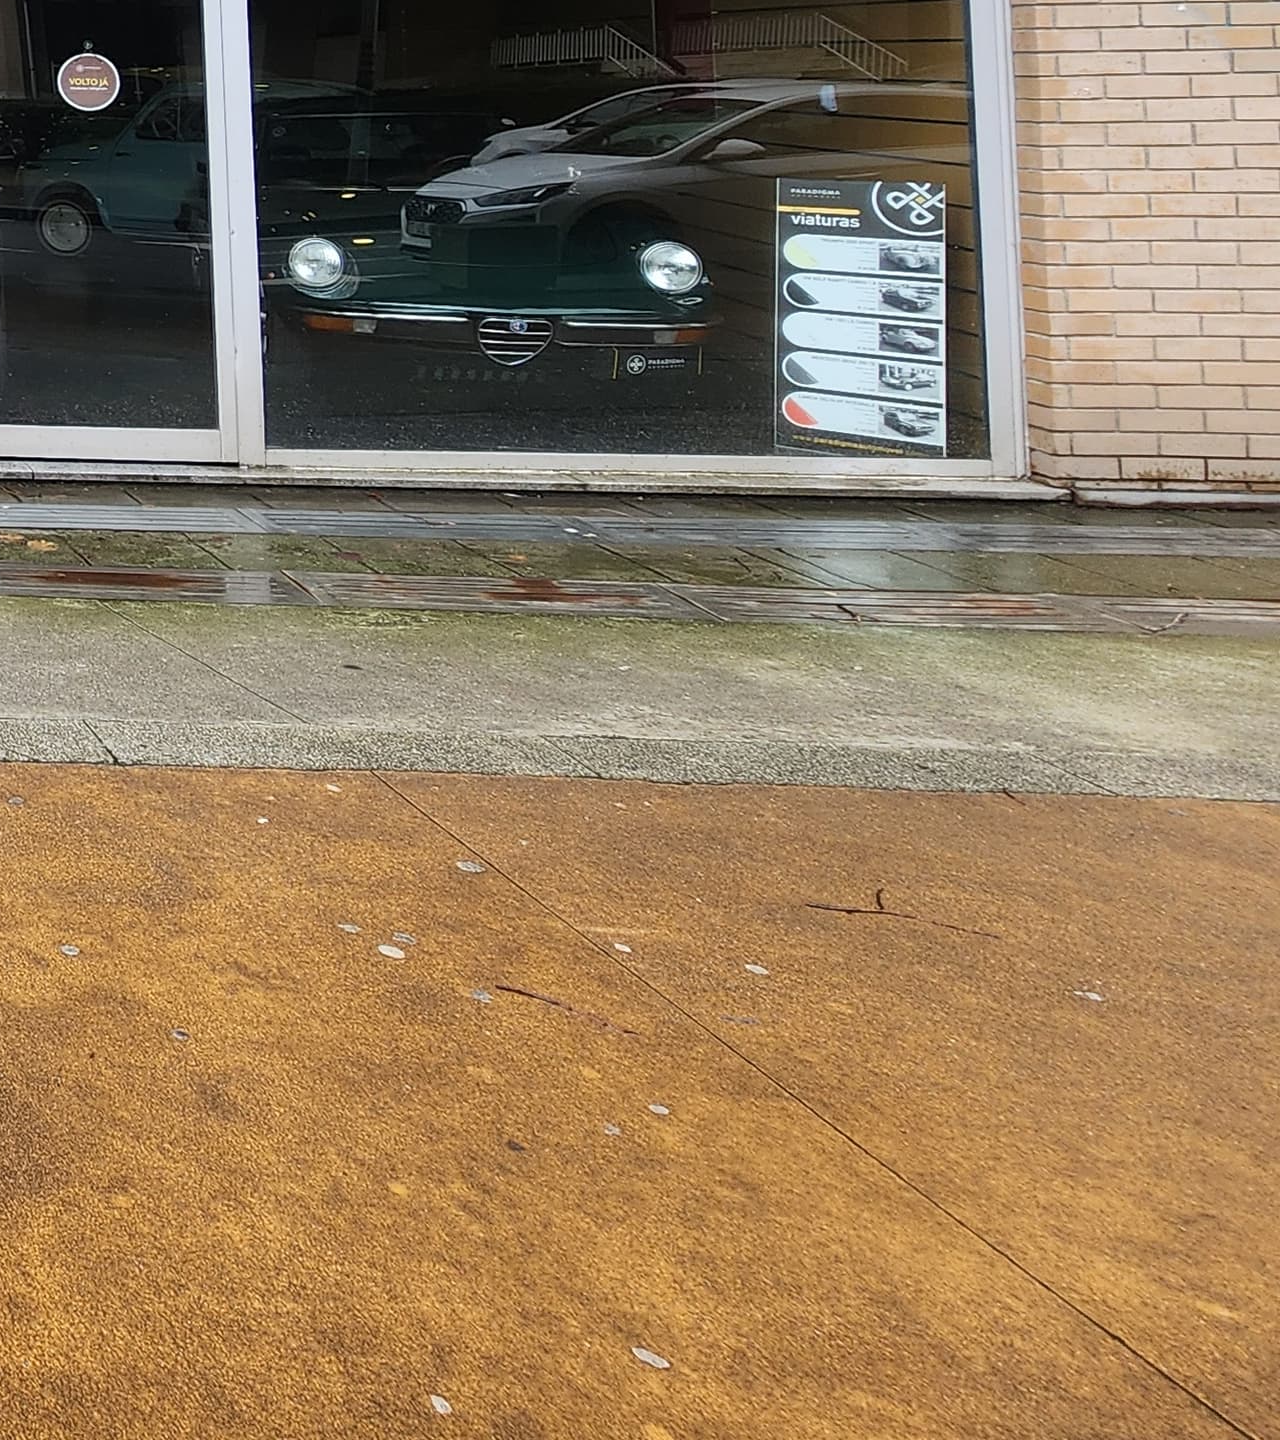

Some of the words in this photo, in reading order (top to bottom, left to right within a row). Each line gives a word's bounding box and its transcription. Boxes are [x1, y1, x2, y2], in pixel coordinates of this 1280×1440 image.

[68, 77, 98, 86] VOLTO
[98, 76, 109, 88] JÁ
[790, 212, 861, 228] viaturas
